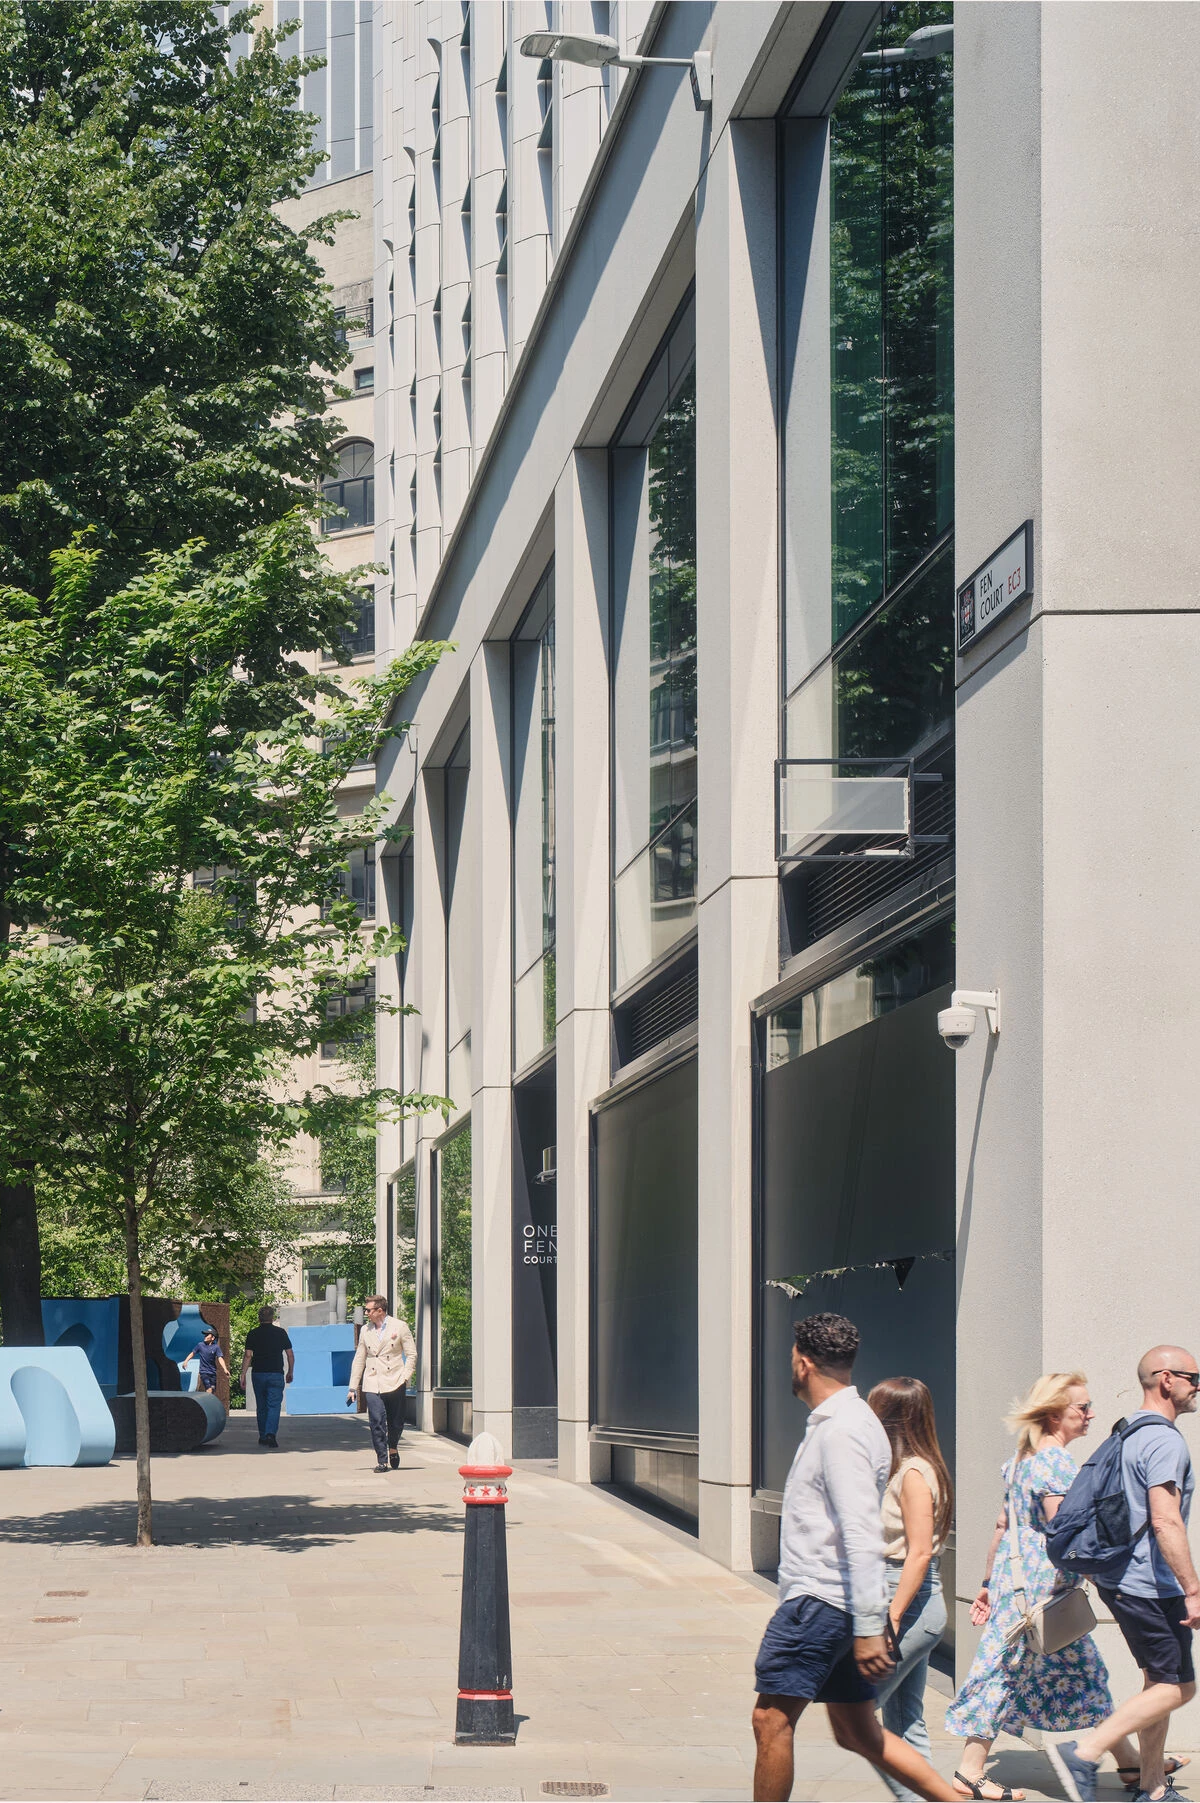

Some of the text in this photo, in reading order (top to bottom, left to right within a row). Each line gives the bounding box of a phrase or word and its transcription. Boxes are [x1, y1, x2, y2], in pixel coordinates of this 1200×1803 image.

[980, 570, 993, 597] FEN
[980, 567, 1021, 620] COURT EC3
[523, 1225, 558, 1237] ONE
[524, 1240, 558, 1253] FEN
